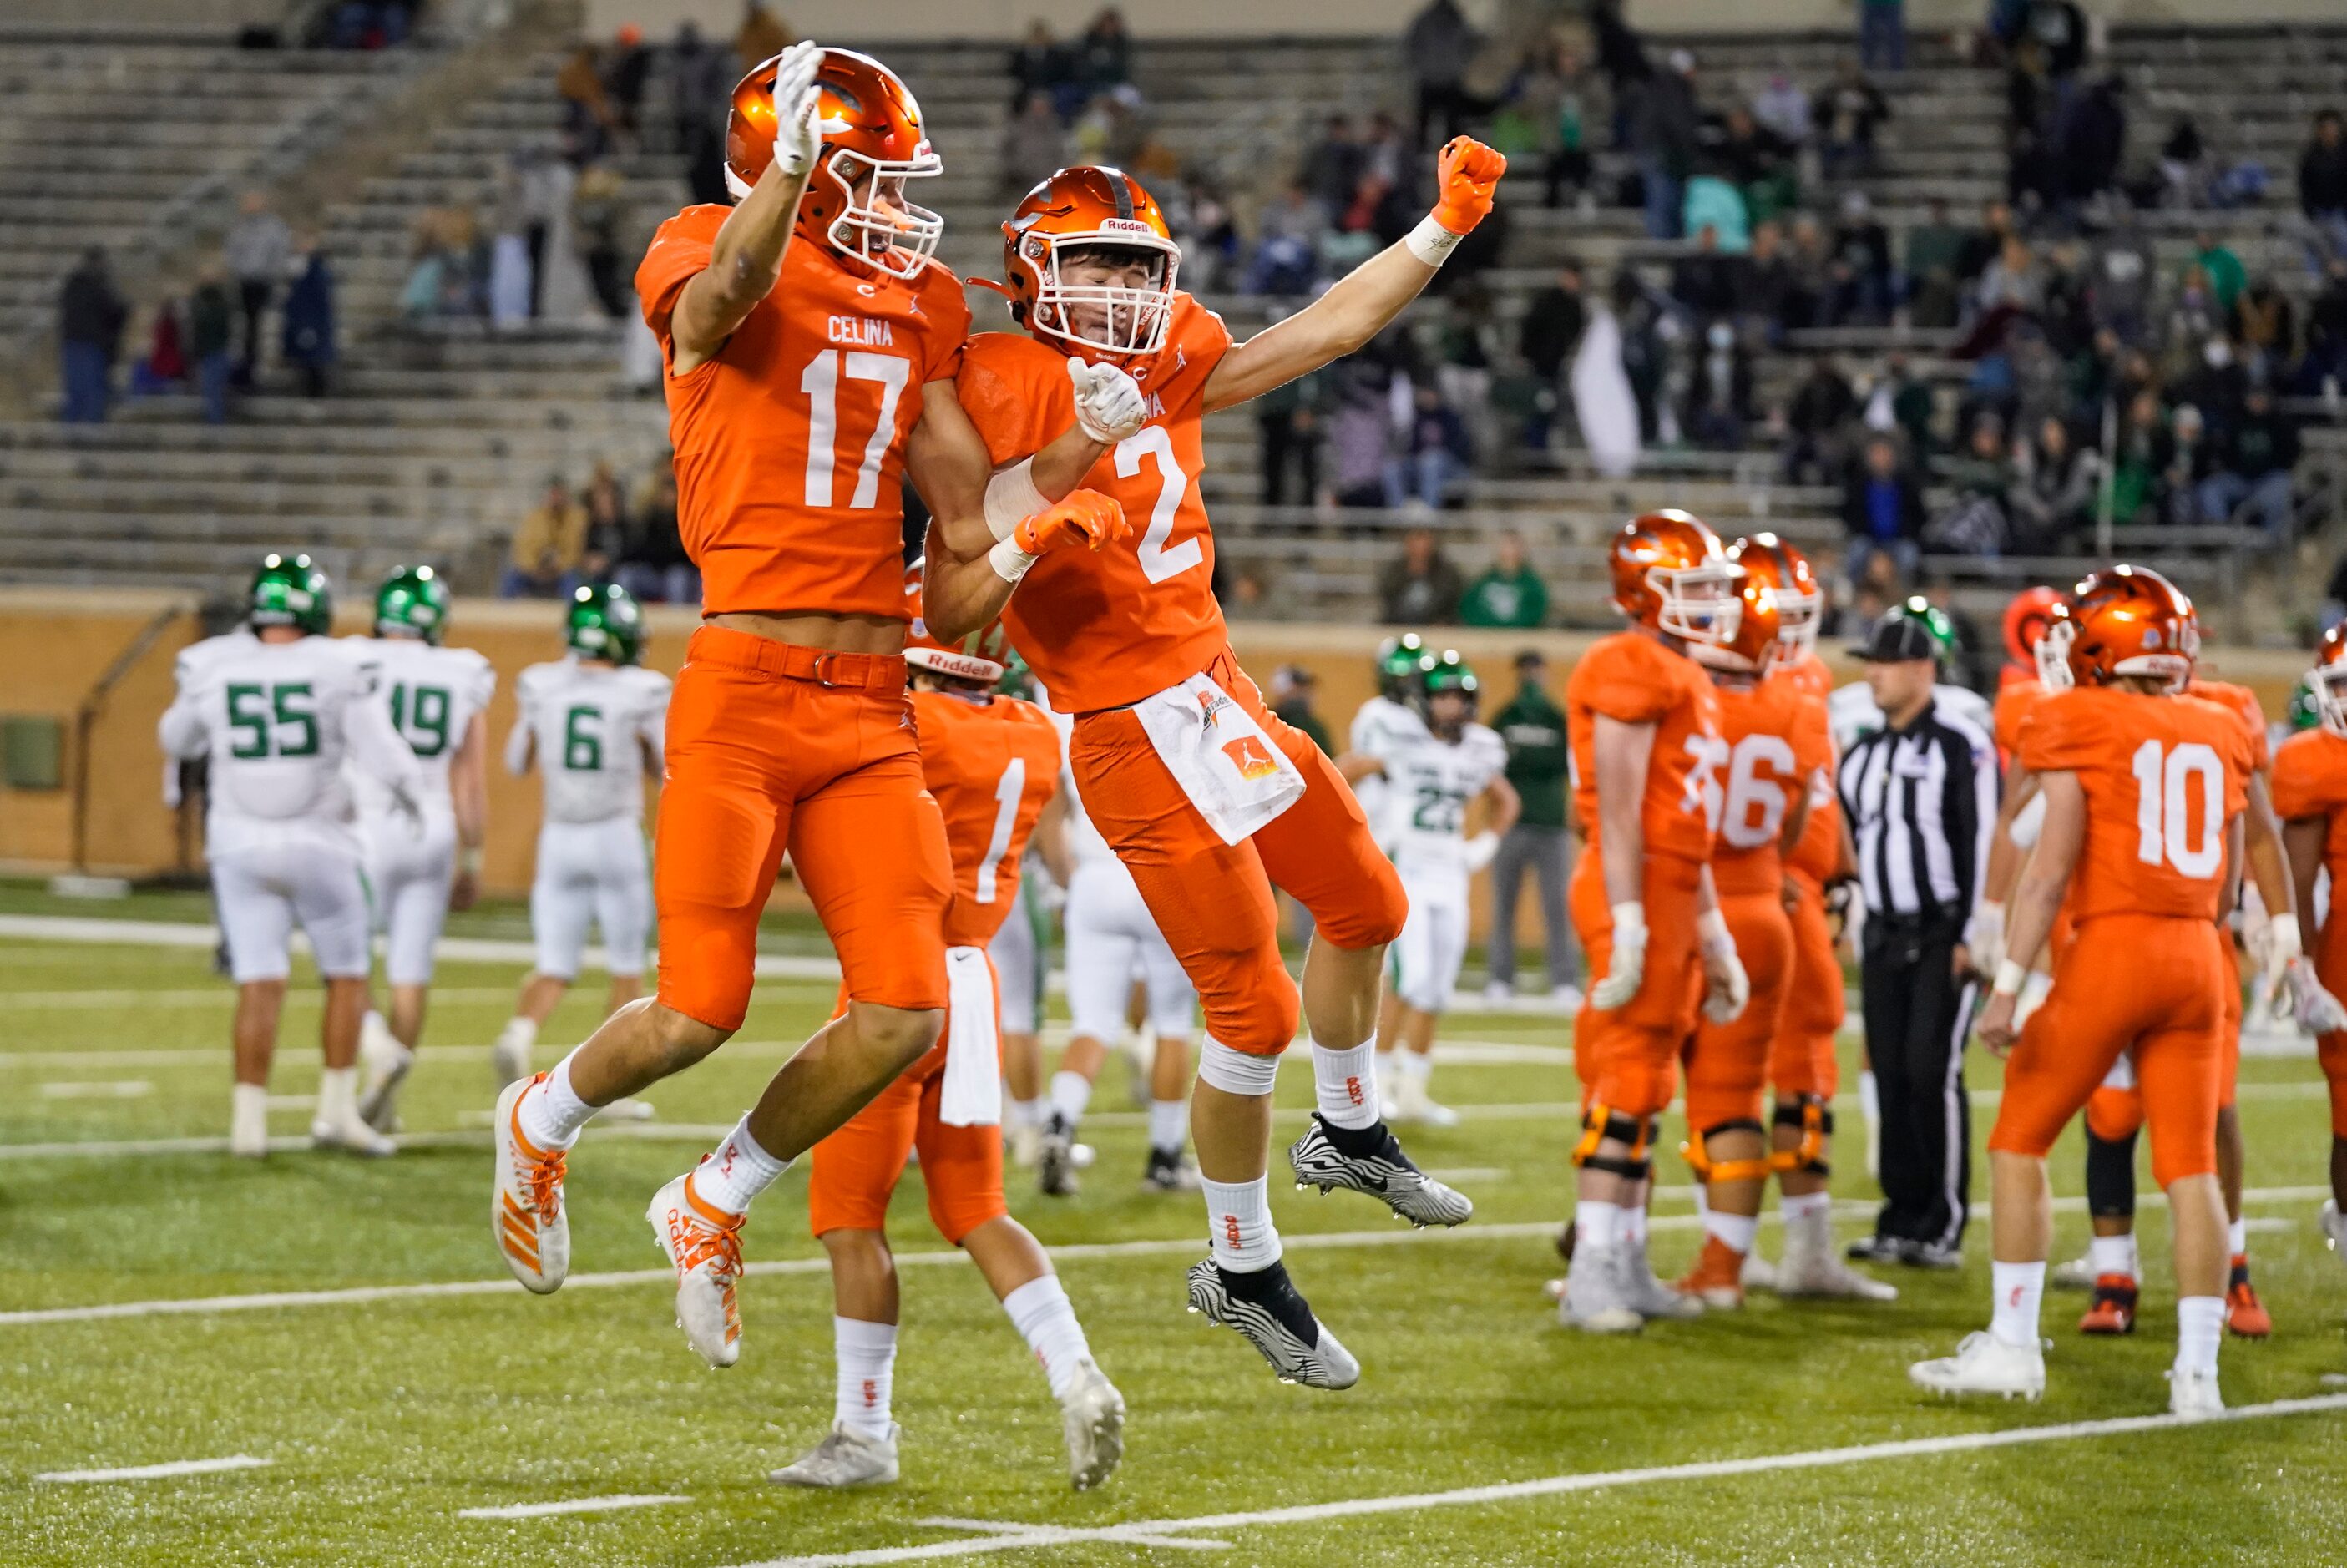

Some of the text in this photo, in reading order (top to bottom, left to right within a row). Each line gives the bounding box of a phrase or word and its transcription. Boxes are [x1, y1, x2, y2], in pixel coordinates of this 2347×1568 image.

[1108, 220, 1149, 232] Riddell
[828, 315, 893, 346] CELINA
[801, 348, 910, 508] 17
[1113, 424, 1203, 584] 2
[928, 654, 993, 675] Riddell
[225, 683, 320, 758] 55
[564, 704, 603, 770] 6
[976, 757, 1025, 904] 1
[2132, 739, 2224, 879] 10
[667, 1208, 685, 1289] adid
